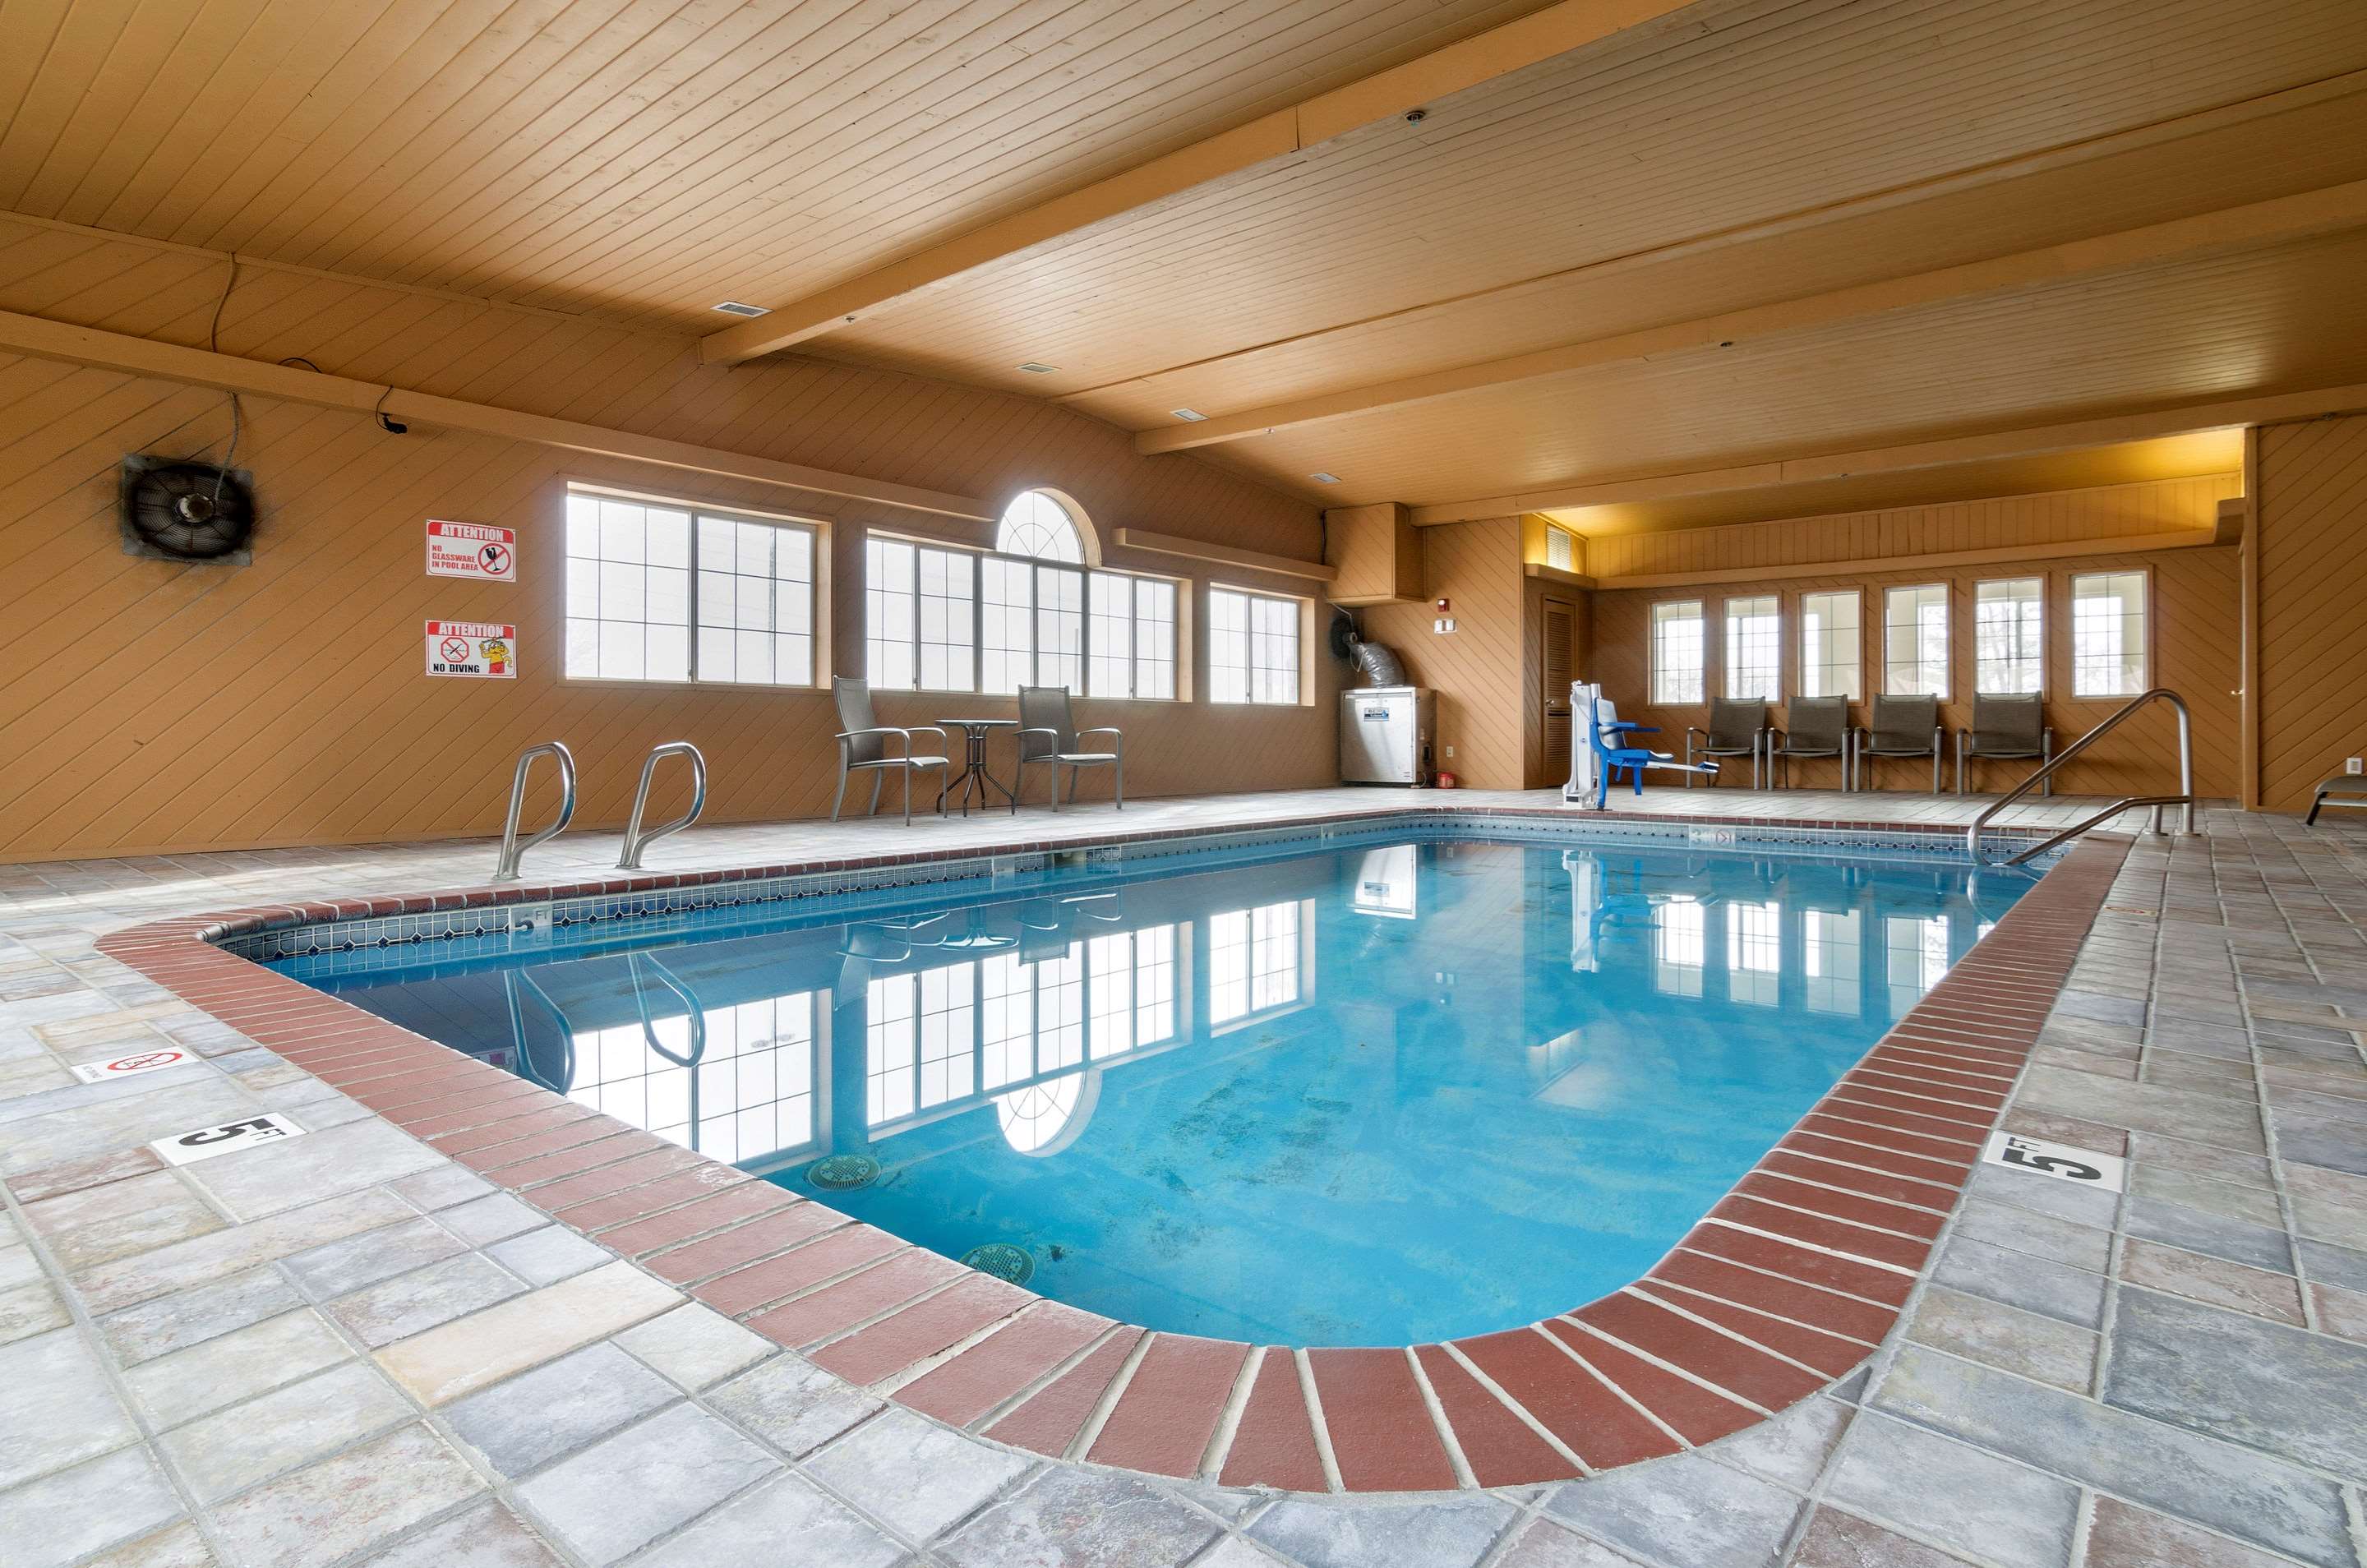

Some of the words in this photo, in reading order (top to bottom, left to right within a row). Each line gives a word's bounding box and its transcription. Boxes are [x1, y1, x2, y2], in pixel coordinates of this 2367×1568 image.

[441, 523, 504, 542] ATTENTION
[432, 553, 475, 563] GLASSWARE
[441, 561, 459, 570] POOL
[461, 563, 478, 571] AREA
[439, 622, 504, 637] ATTENTION
[433, 663, 445, 671] NO
[450, 664, 480, 673] DIVING
[178, 1118, 276, 1146] 5
[250, 1128, 287, 1141] FT
[2007, 1137, 2041, 1152] FT
[2002, 1148, 2102, 1180] 5
